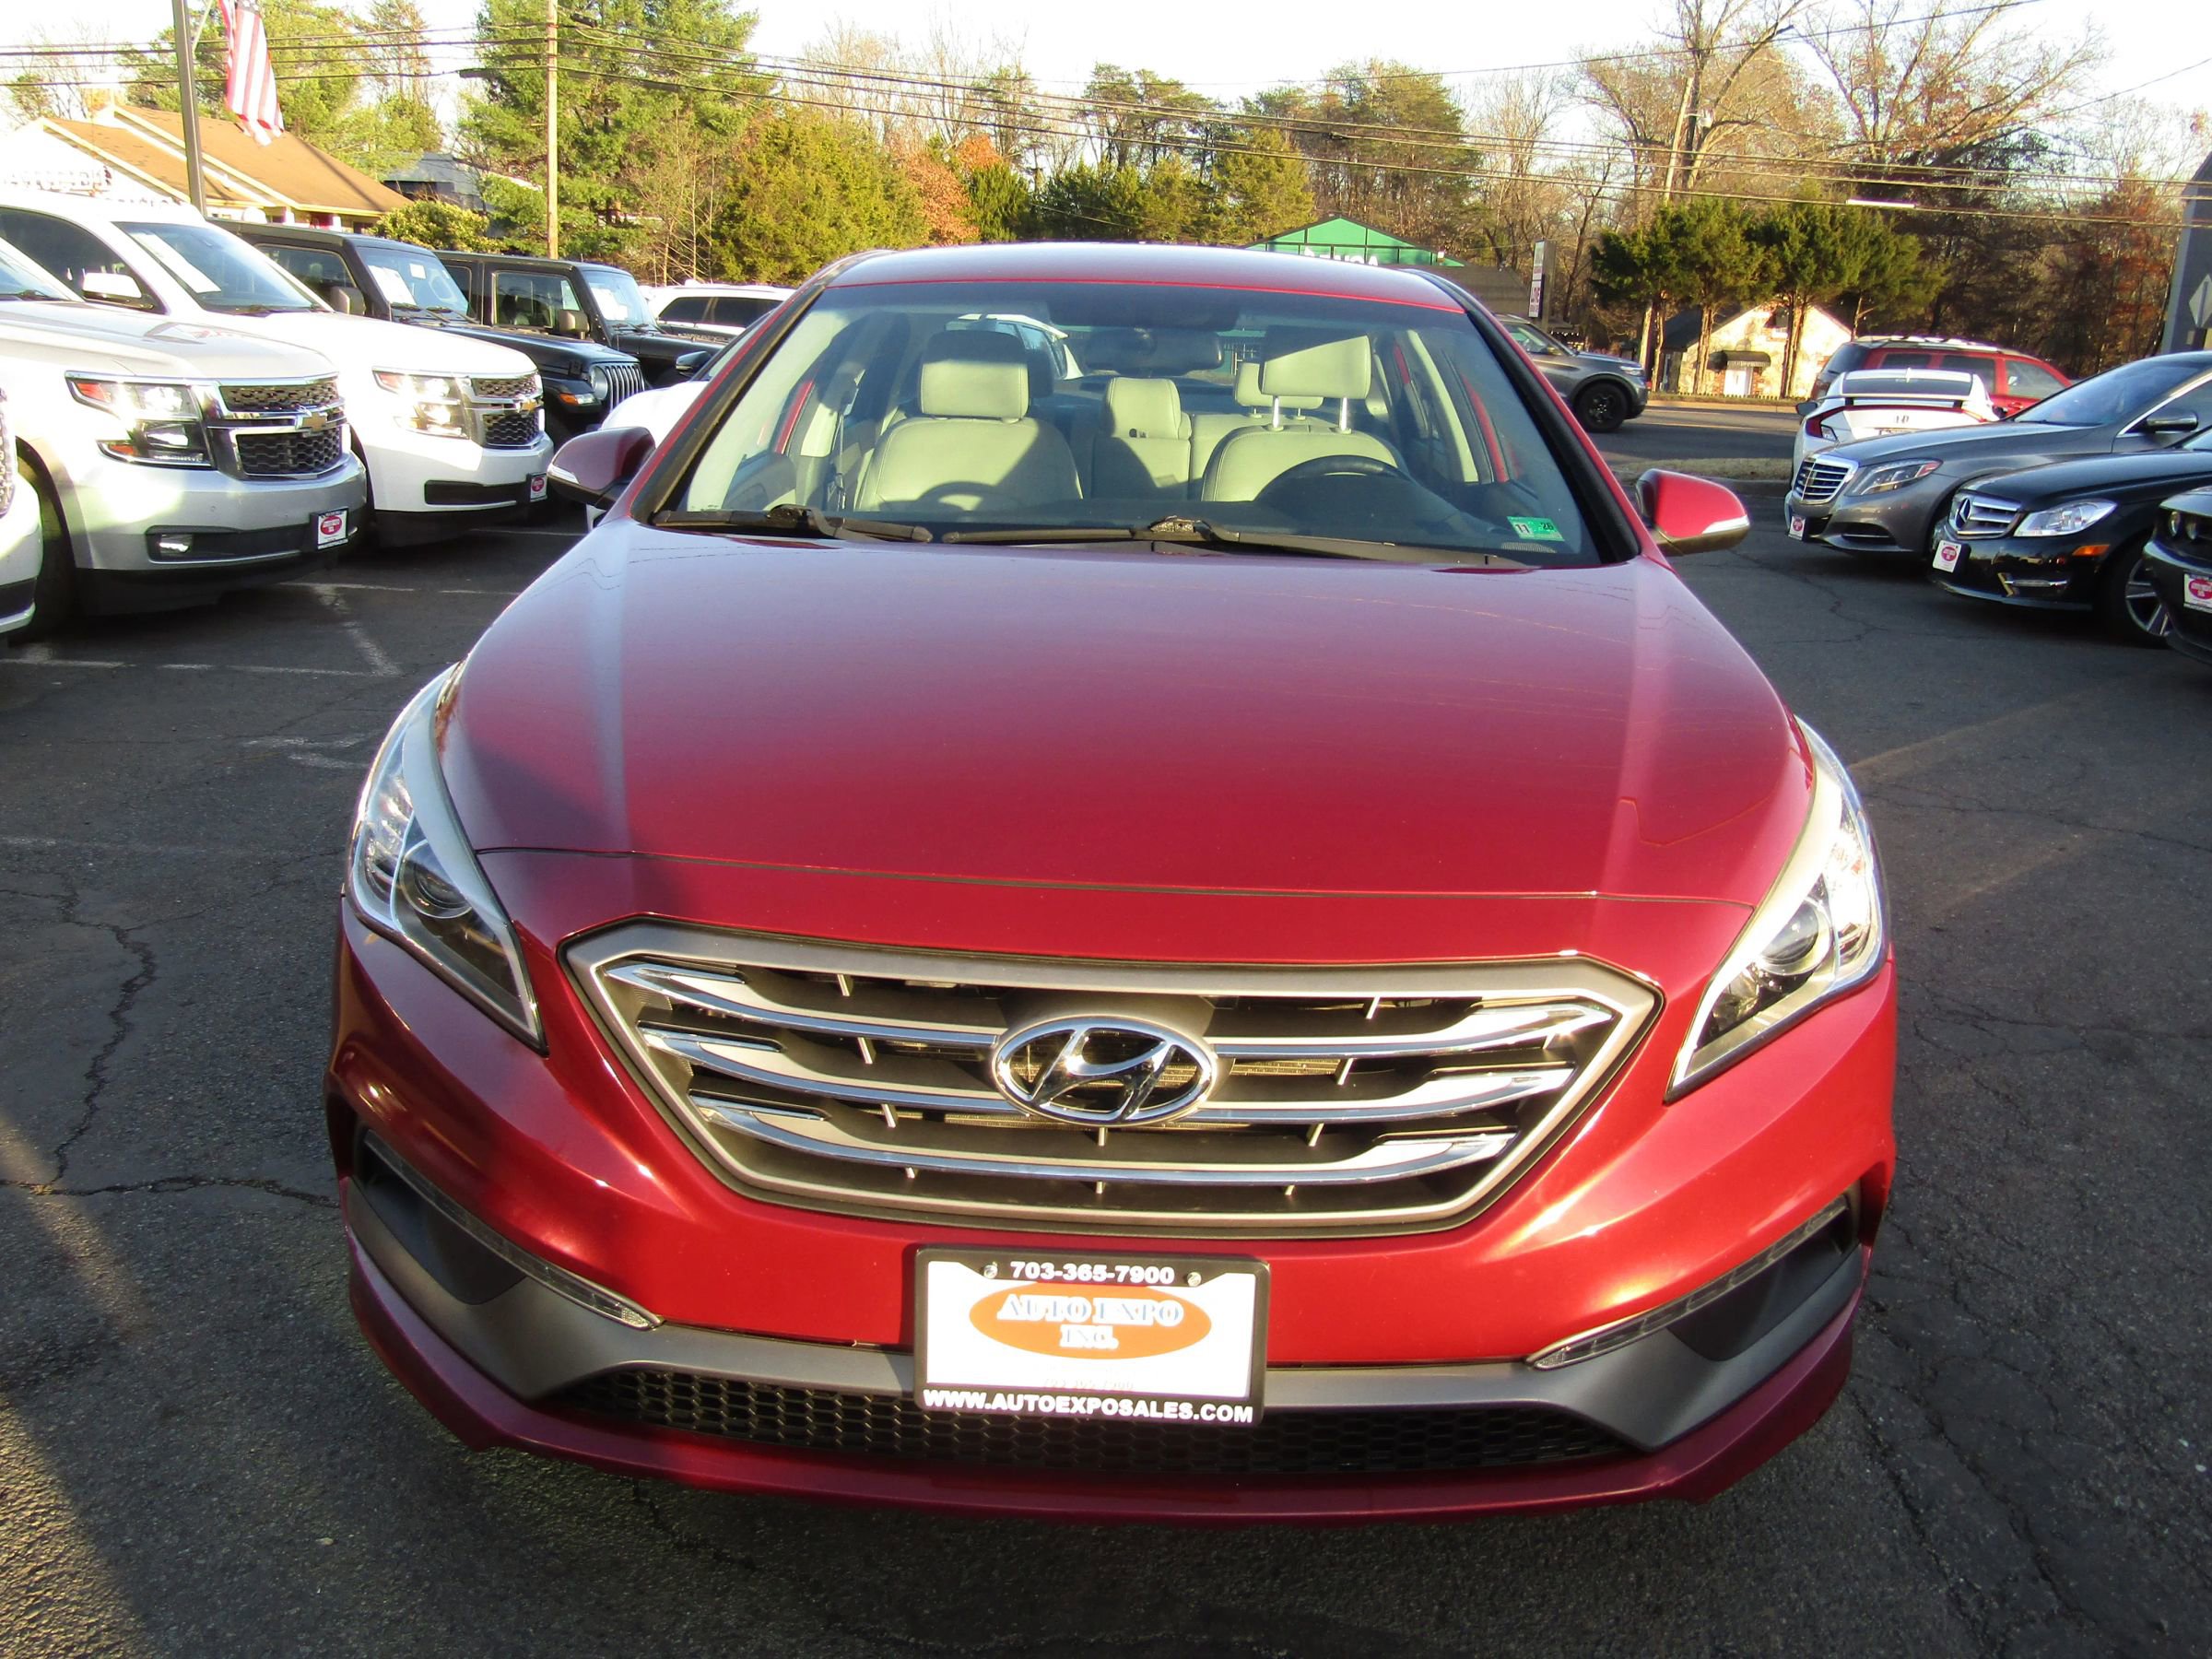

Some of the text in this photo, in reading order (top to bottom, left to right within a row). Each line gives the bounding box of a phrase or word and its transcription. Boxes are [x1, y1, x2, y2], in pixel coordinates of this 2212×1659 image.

[1010, 1261, 1175, 1285] 703-365-7900
[996, 1293, 1184, 1327] AUTO EXPO
[923, 1389, 1253, 1423] WWW.AUTOEXPOSALES.COM
